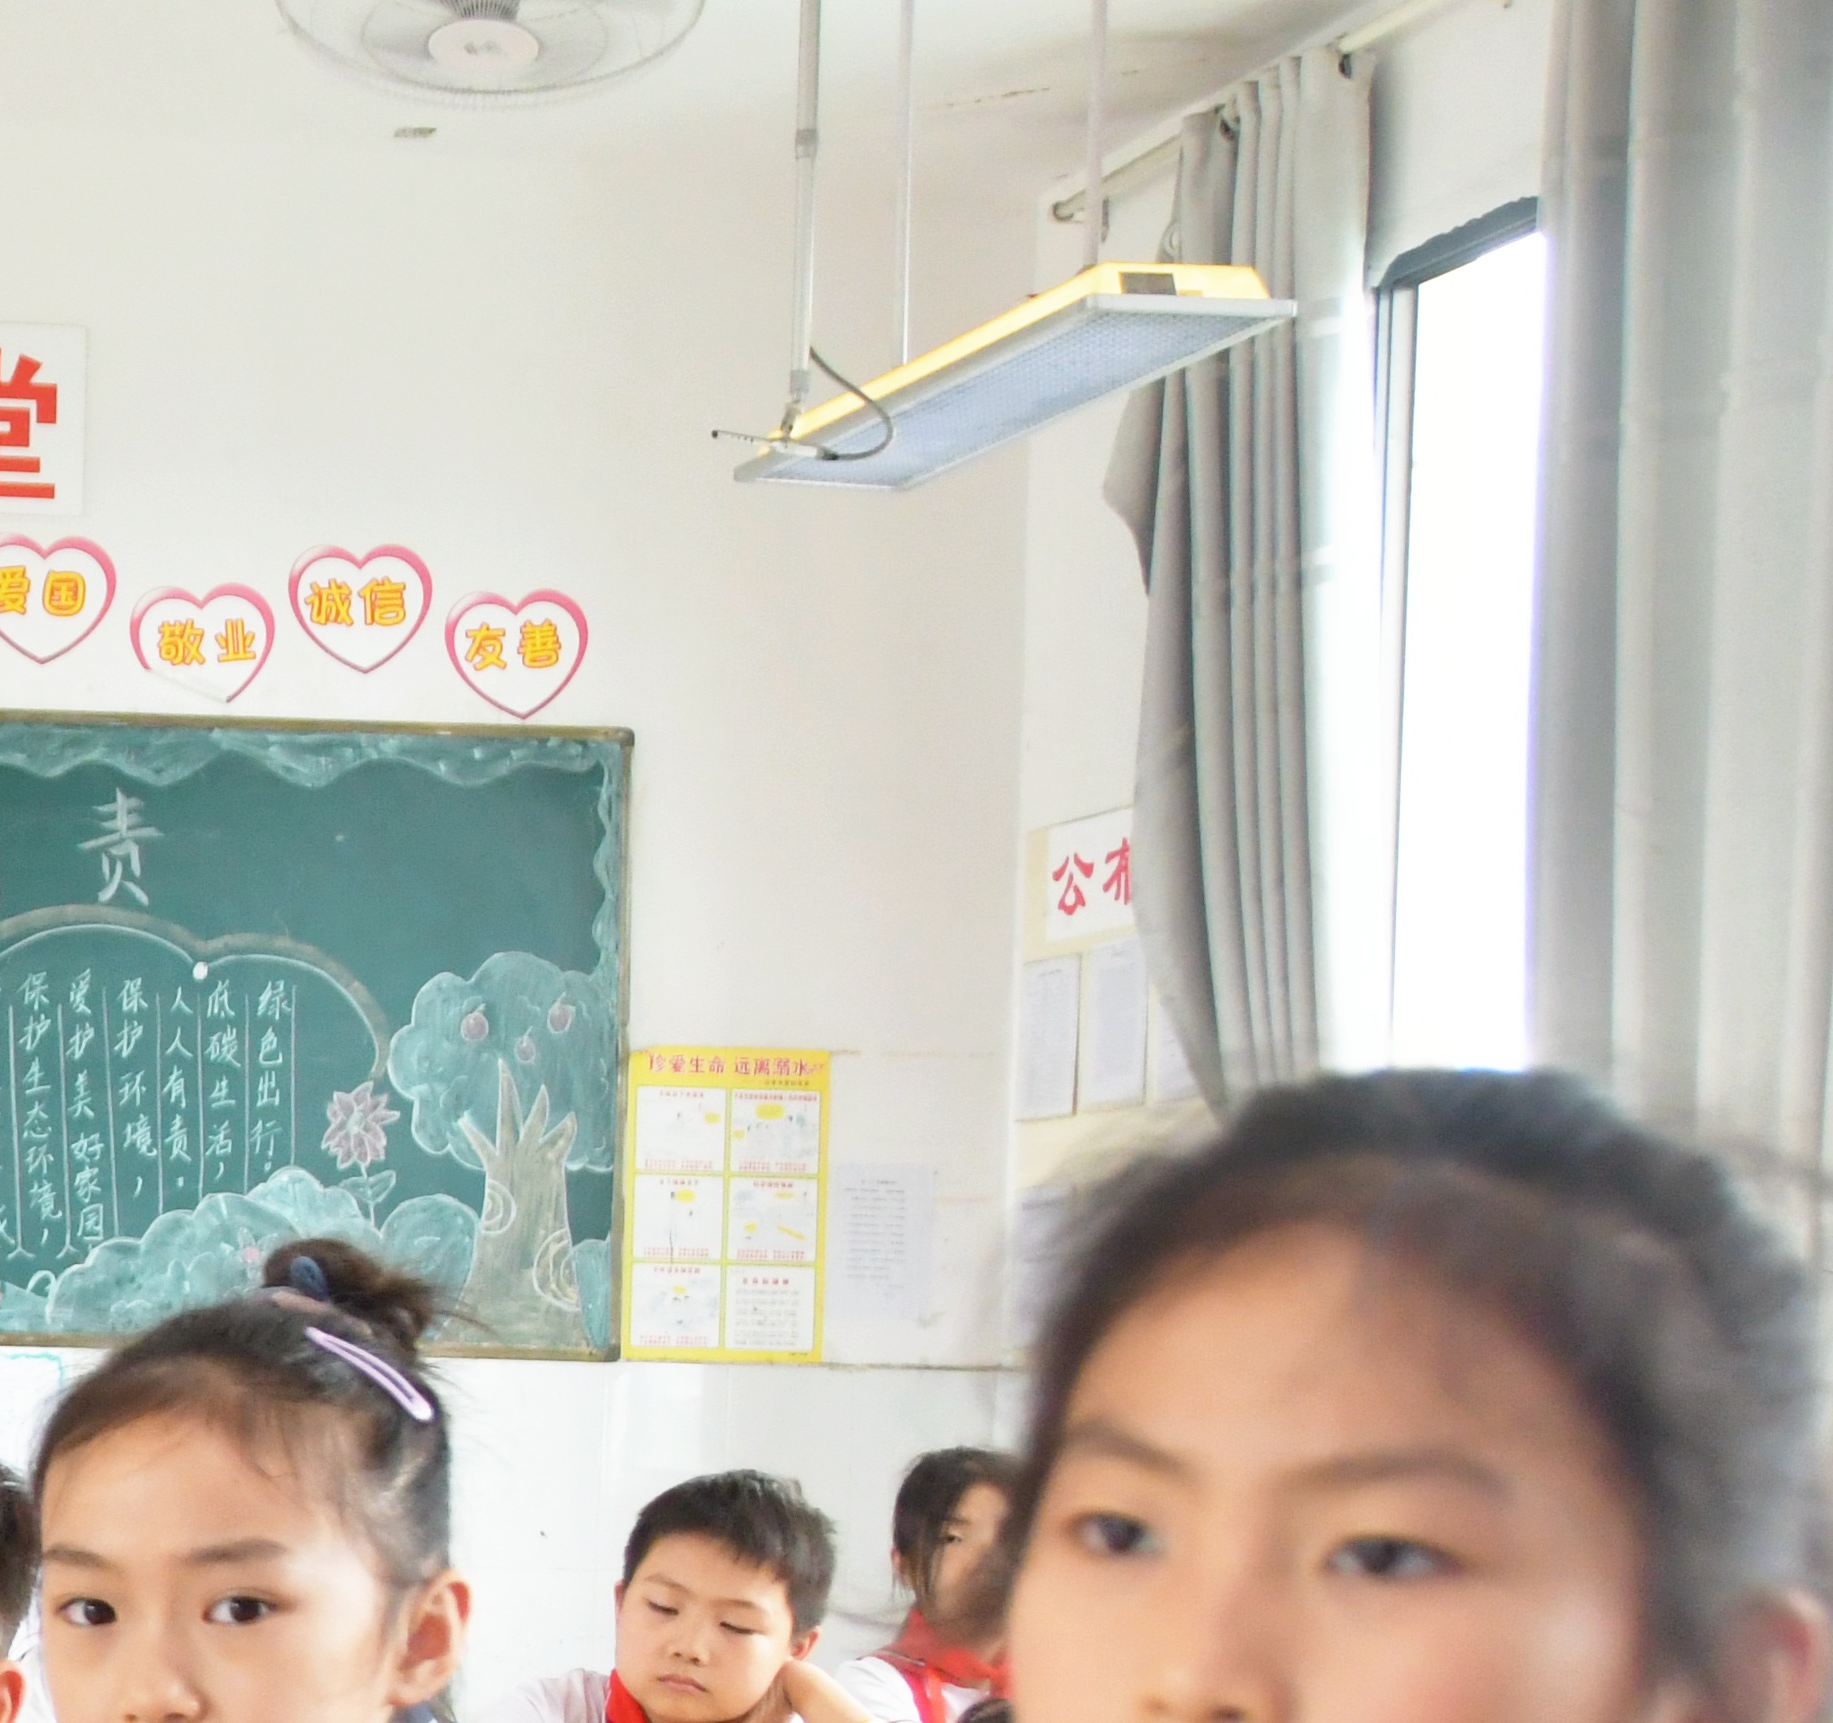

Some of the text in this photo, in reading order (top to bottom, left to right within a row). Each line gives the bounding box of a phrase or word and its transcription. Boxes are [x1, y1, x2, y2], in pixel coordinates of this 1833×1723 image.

[303, 577, 407, 628] 诚信
[157, 619, 257, 666] 敬业
[464, 621, 563, 671] 友善
